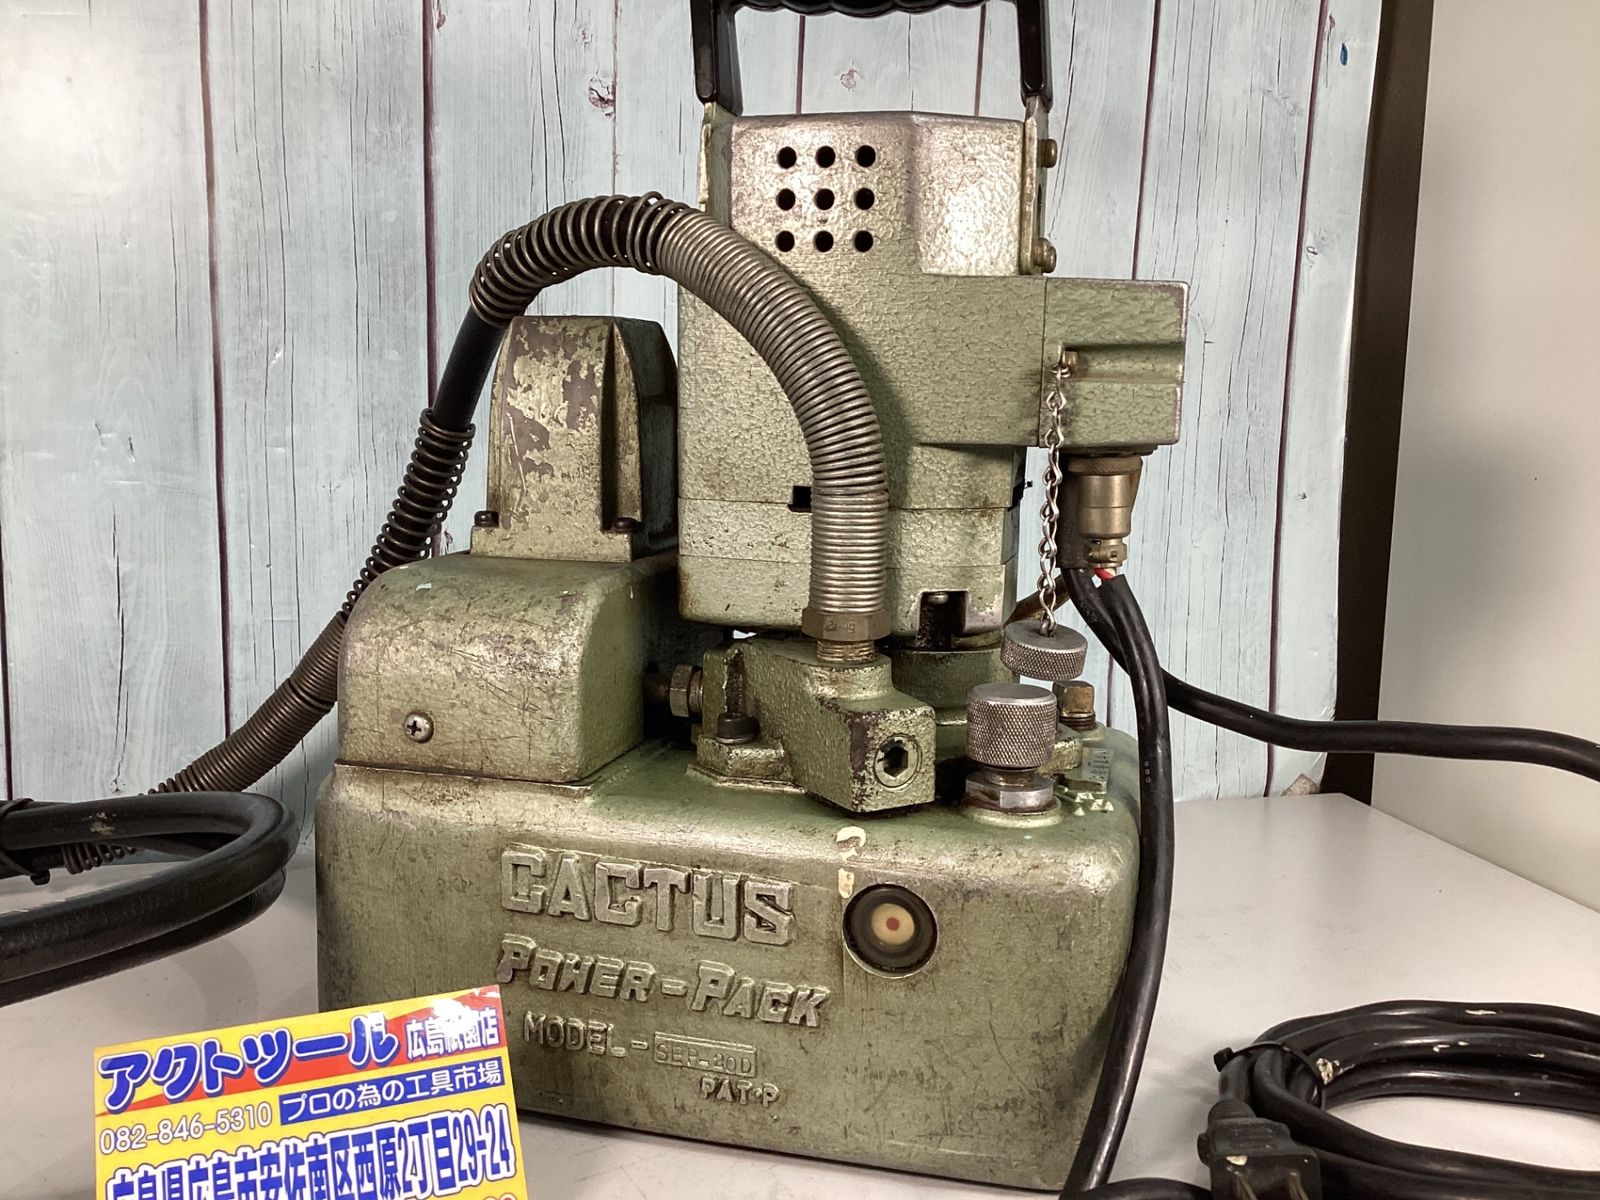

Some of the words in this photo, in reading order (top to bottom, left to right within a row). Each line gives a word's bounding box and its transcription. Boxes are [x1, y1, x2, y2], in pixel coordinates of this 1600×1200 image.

[500, 845, 797, 946] CACTUS
[98, 1010, 399, 1112] アクトツール
[284, 1061, 502, 1122] プロの為の工具市場
[100, 1101, 272, 1155] 082-846-5310
